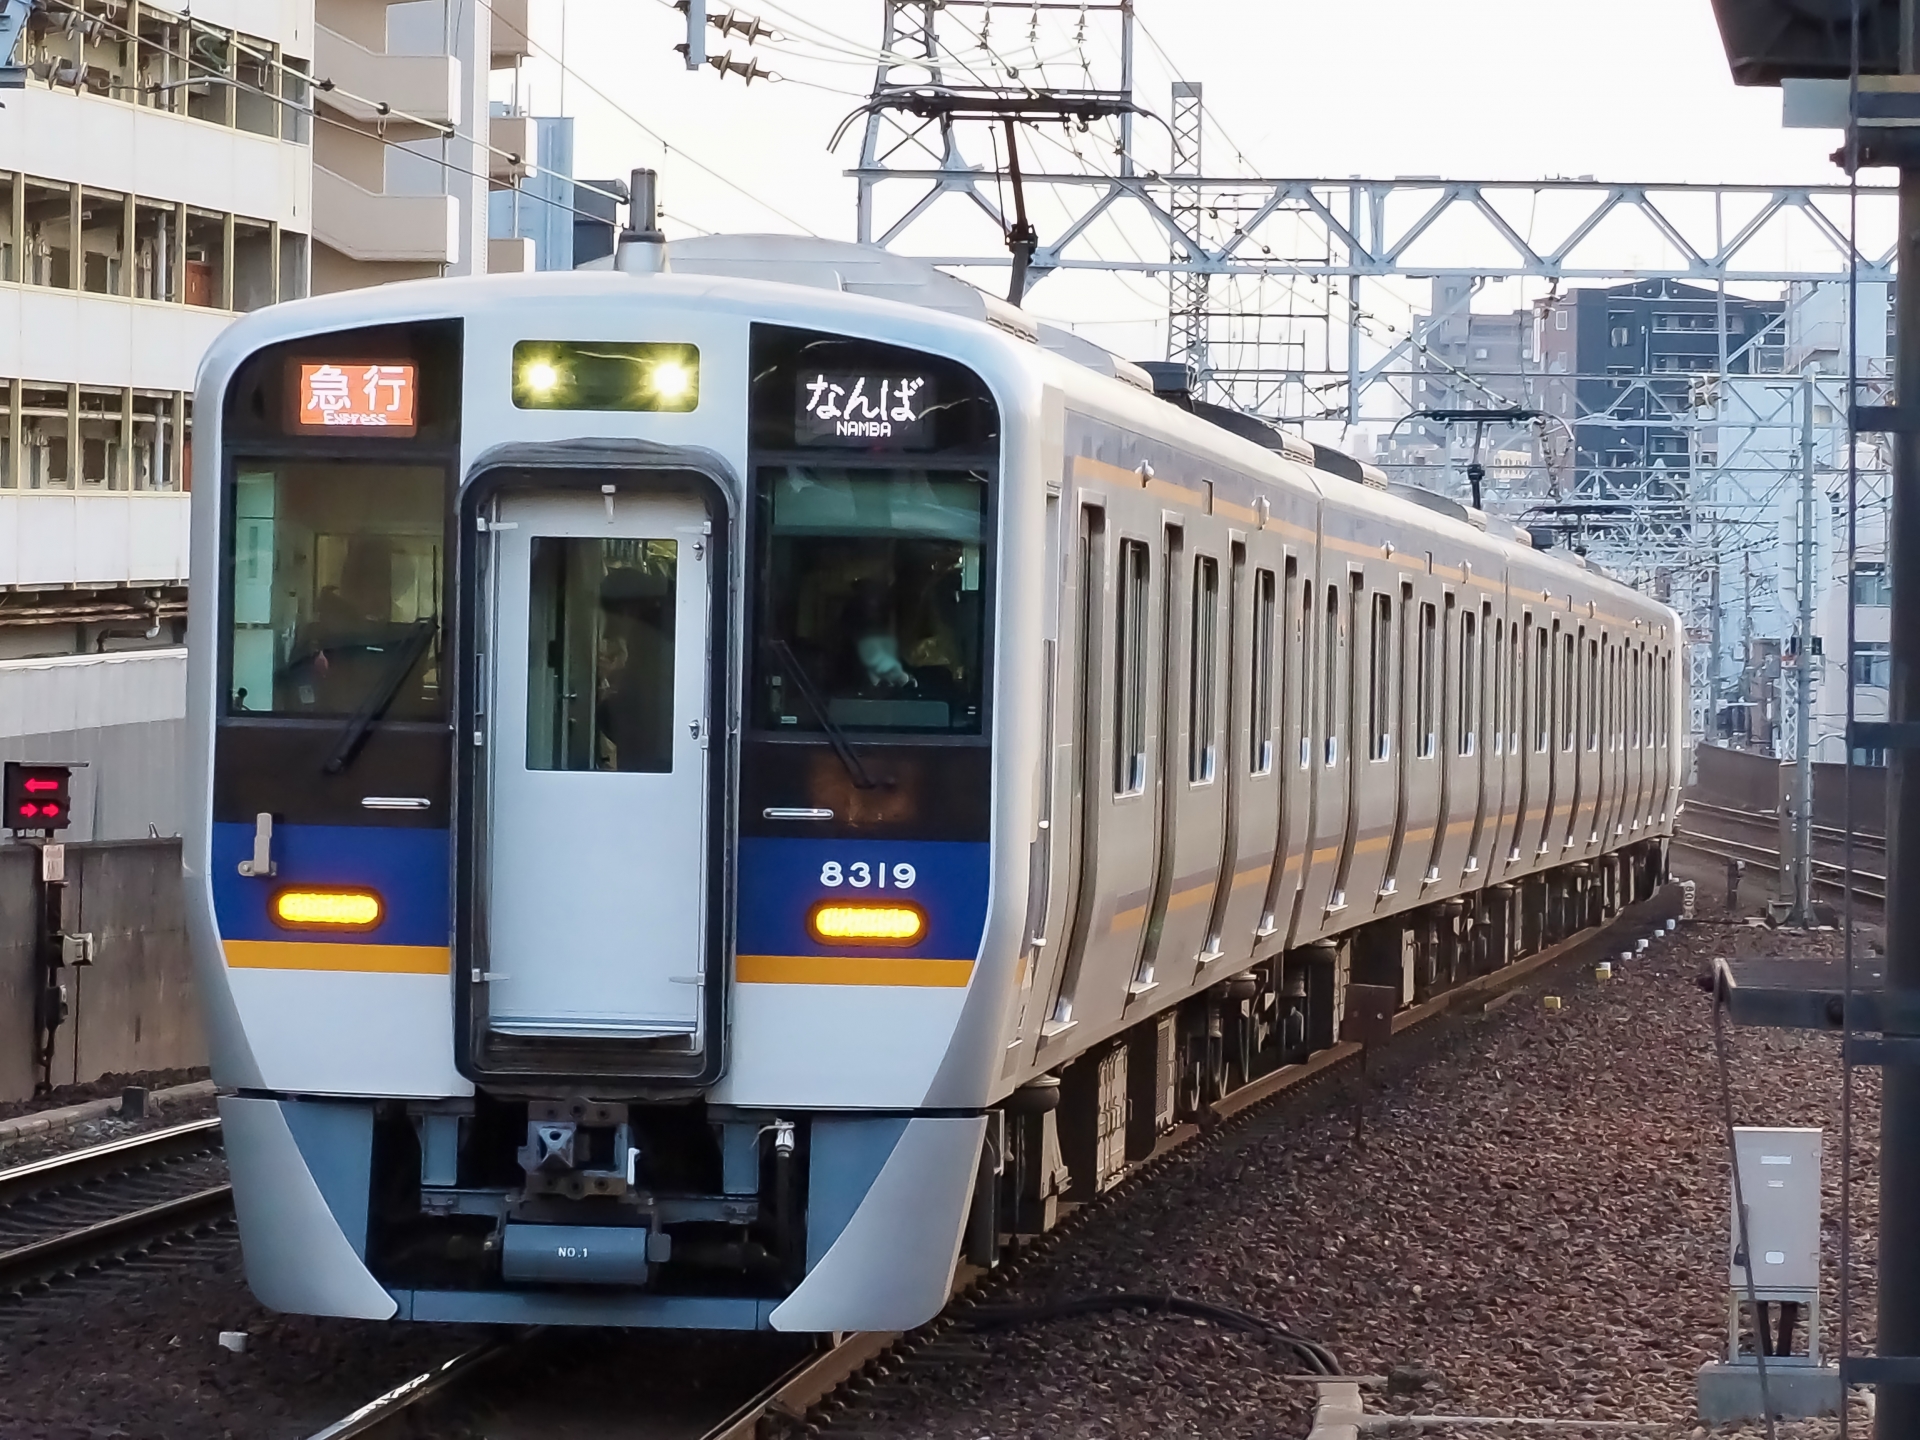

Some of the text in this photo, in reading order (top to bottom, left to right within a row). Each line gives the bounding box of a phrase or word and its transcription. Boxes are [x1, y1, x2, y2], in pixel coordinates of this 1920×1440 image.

[307, 364, 406, 411] 急行
[806, 374, 925, 421] なんば
[836, 421, 891, 437] NAMBA
[820, 861, 916, 889] 8319
[557, 1247, 588, 1258] NO.1
